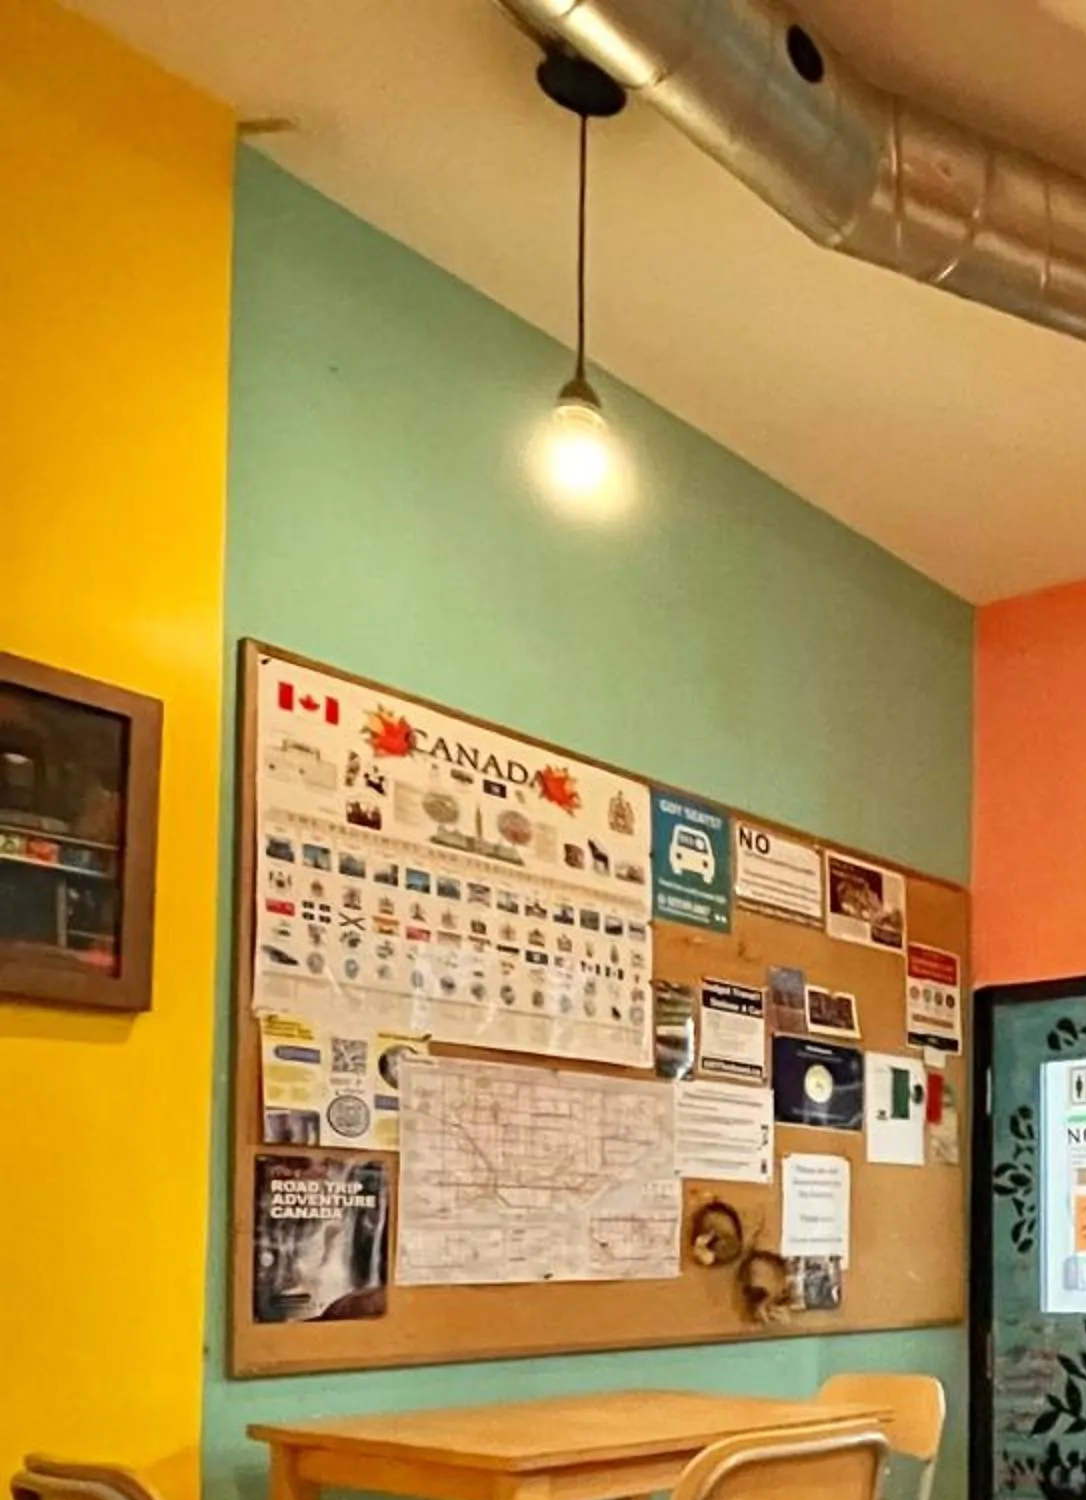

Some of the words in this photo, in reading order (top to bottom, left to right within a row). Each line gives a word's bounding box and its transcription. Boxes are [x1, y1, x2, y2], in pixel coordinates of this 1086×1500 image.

[738, 826, 770, 855] NO
[271, 1179, 321, 1193] ROAD
[324, 1181, 364, 1195] TRIP
[271, 1193, 377, 1208] ADVENTURE
[270, 1206, 344, 1219] CANADA
